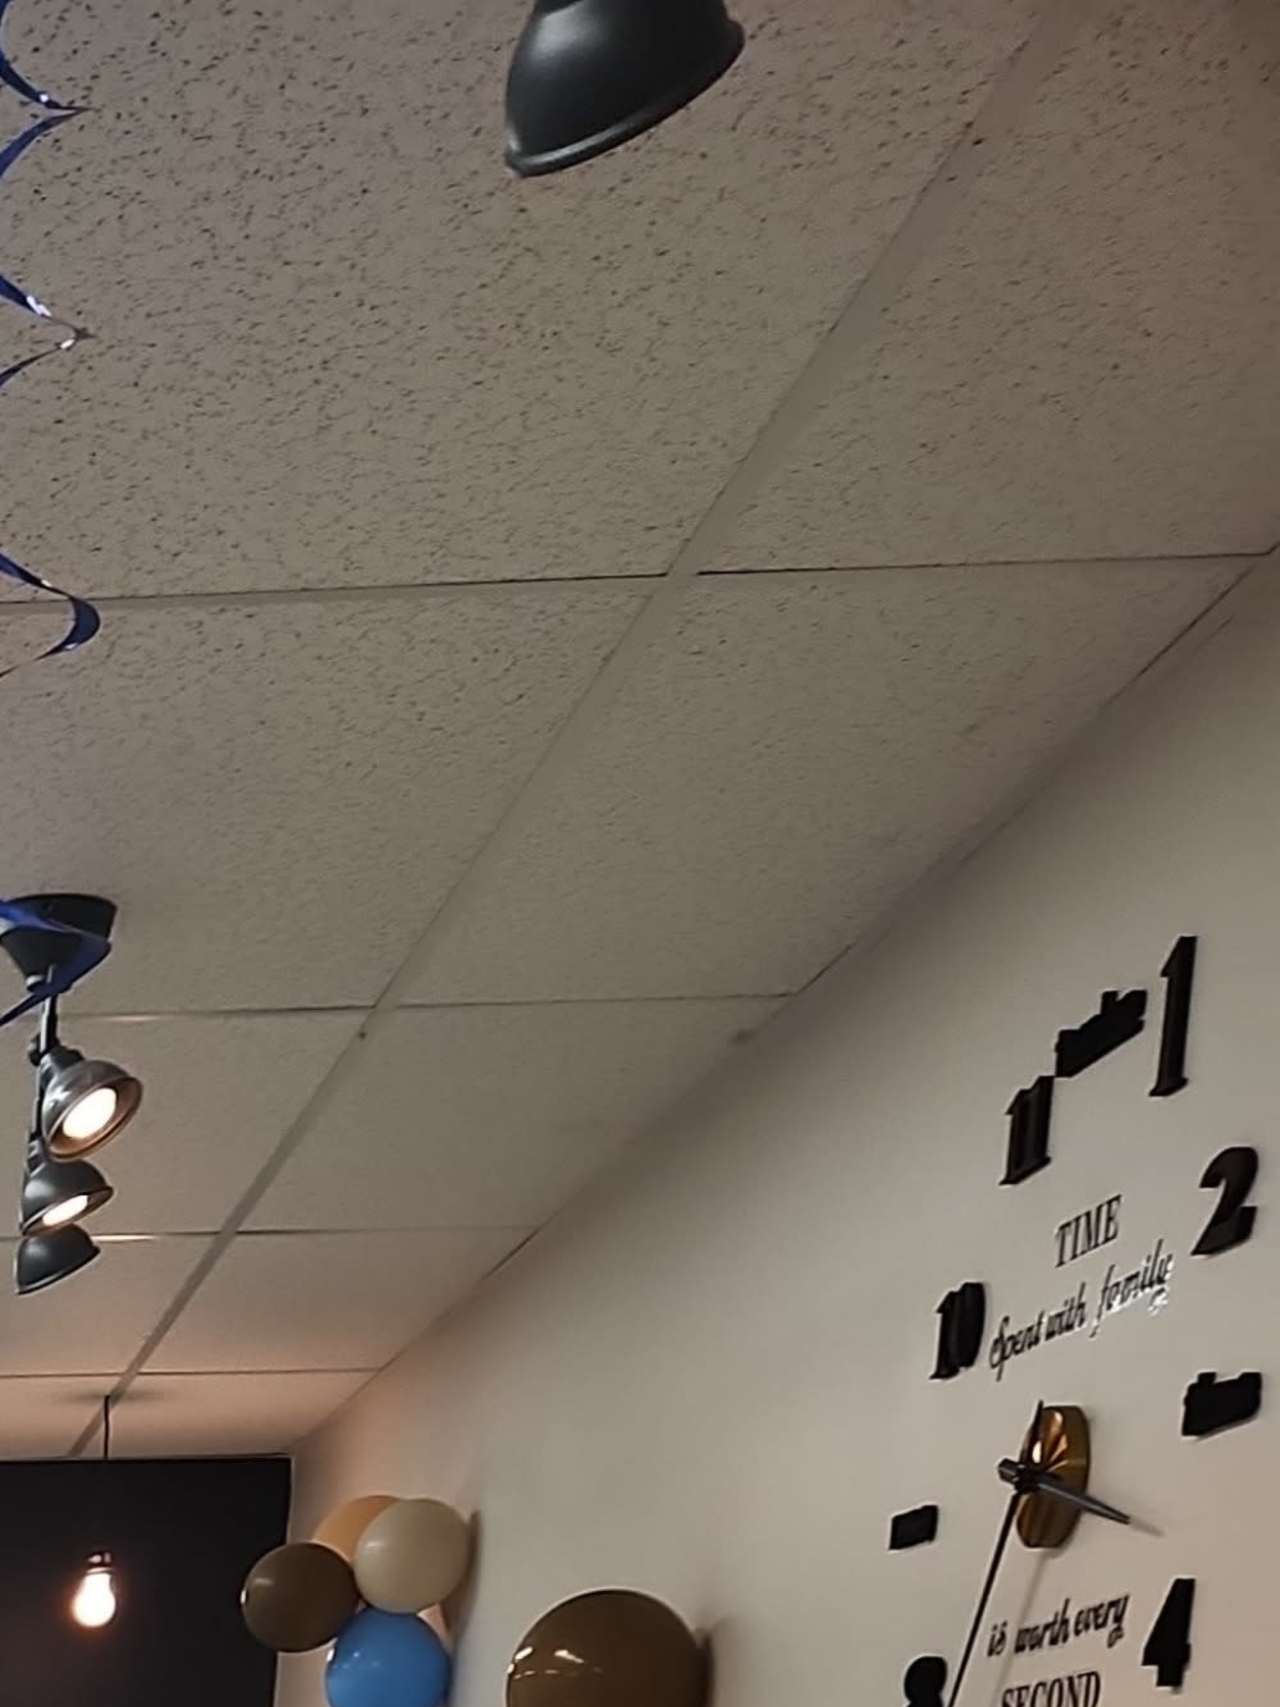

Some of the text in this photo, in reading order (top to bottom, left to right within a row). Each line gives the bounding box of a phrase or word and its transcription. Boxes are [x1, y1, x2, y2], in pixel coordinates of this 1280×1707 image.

[1149, 935, 1198, 1097] 1
[1054, 1194, 1123, 1268] TIME
[1190, 1146, 1259, 1256] 2
[929, 1282, 986, 1380] 10
[1044, 1281, 1087, 1341] with
[986, 1594, 1131, 1658] is worth every
[1141, 1577, 1197, 1688] 4
